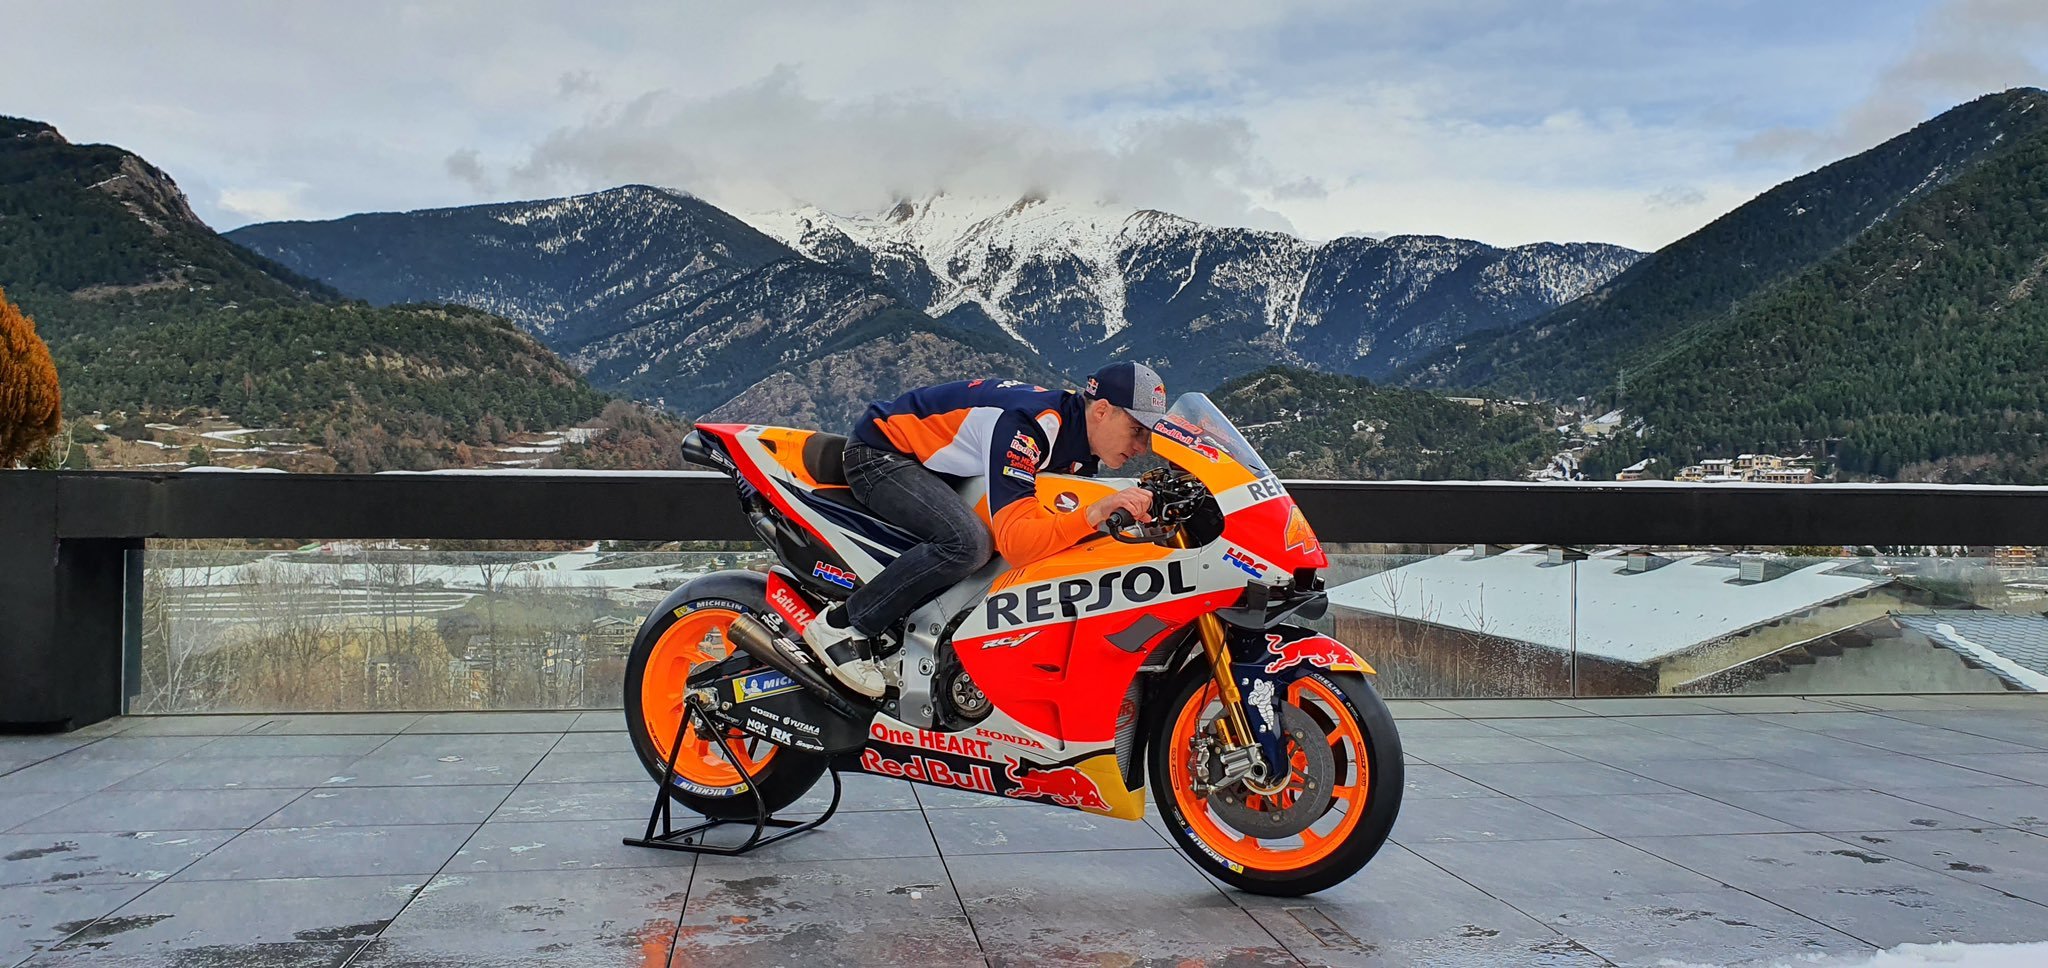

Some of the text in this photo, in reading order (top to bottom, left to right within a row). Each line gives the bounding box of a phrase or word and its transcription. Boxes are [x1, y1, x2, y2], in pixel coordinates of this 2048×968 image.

[1222, 547, 1268, 579] HRC
[812, 560, 857, 590] HRC
[696, 600, 743, 611] MICHELIN
[771, 588, 798, 614] Satu
[987, 560, 1197, 630] REPSOL
[750, 706, 780, 722] GOSHI
[747, 718, 769, 733] NGK
[771, 727, 793, 745] RK
[790, 719, 820, 735] YUTAKA
[871, 723, 914, 745] One
[975, 728, 1045, 749] HONDA
[860, 748, 997, 794] Red Bull
[680, 781, 728, 797] MICHELIN
[1188, 832, 1225, 864] MICHELIN
